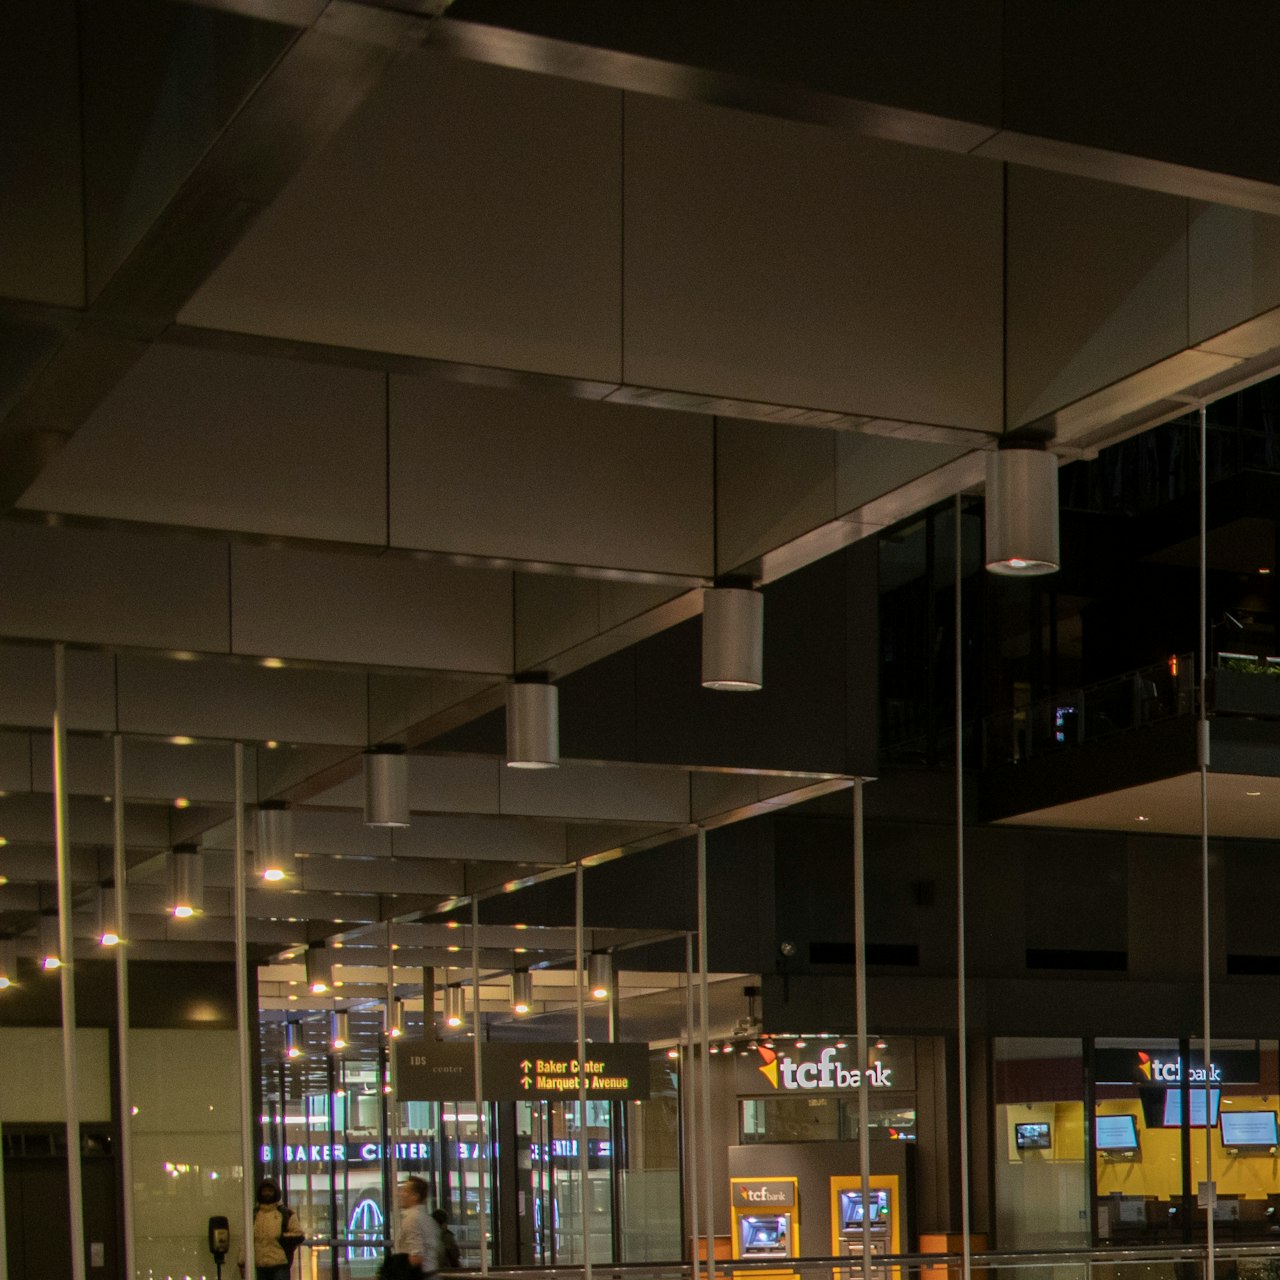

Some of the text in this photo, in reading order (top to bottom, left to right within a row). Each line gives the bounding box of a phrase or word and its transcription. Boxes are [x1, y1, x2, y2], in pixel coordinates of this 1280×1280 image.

[410, 1056, 427, 1066] IDS
[536, 1059, 606, 1073] Baker Cnter
[432, 1064, 464, 1073] center
[591, 1075, 629, 1089] Avenue
